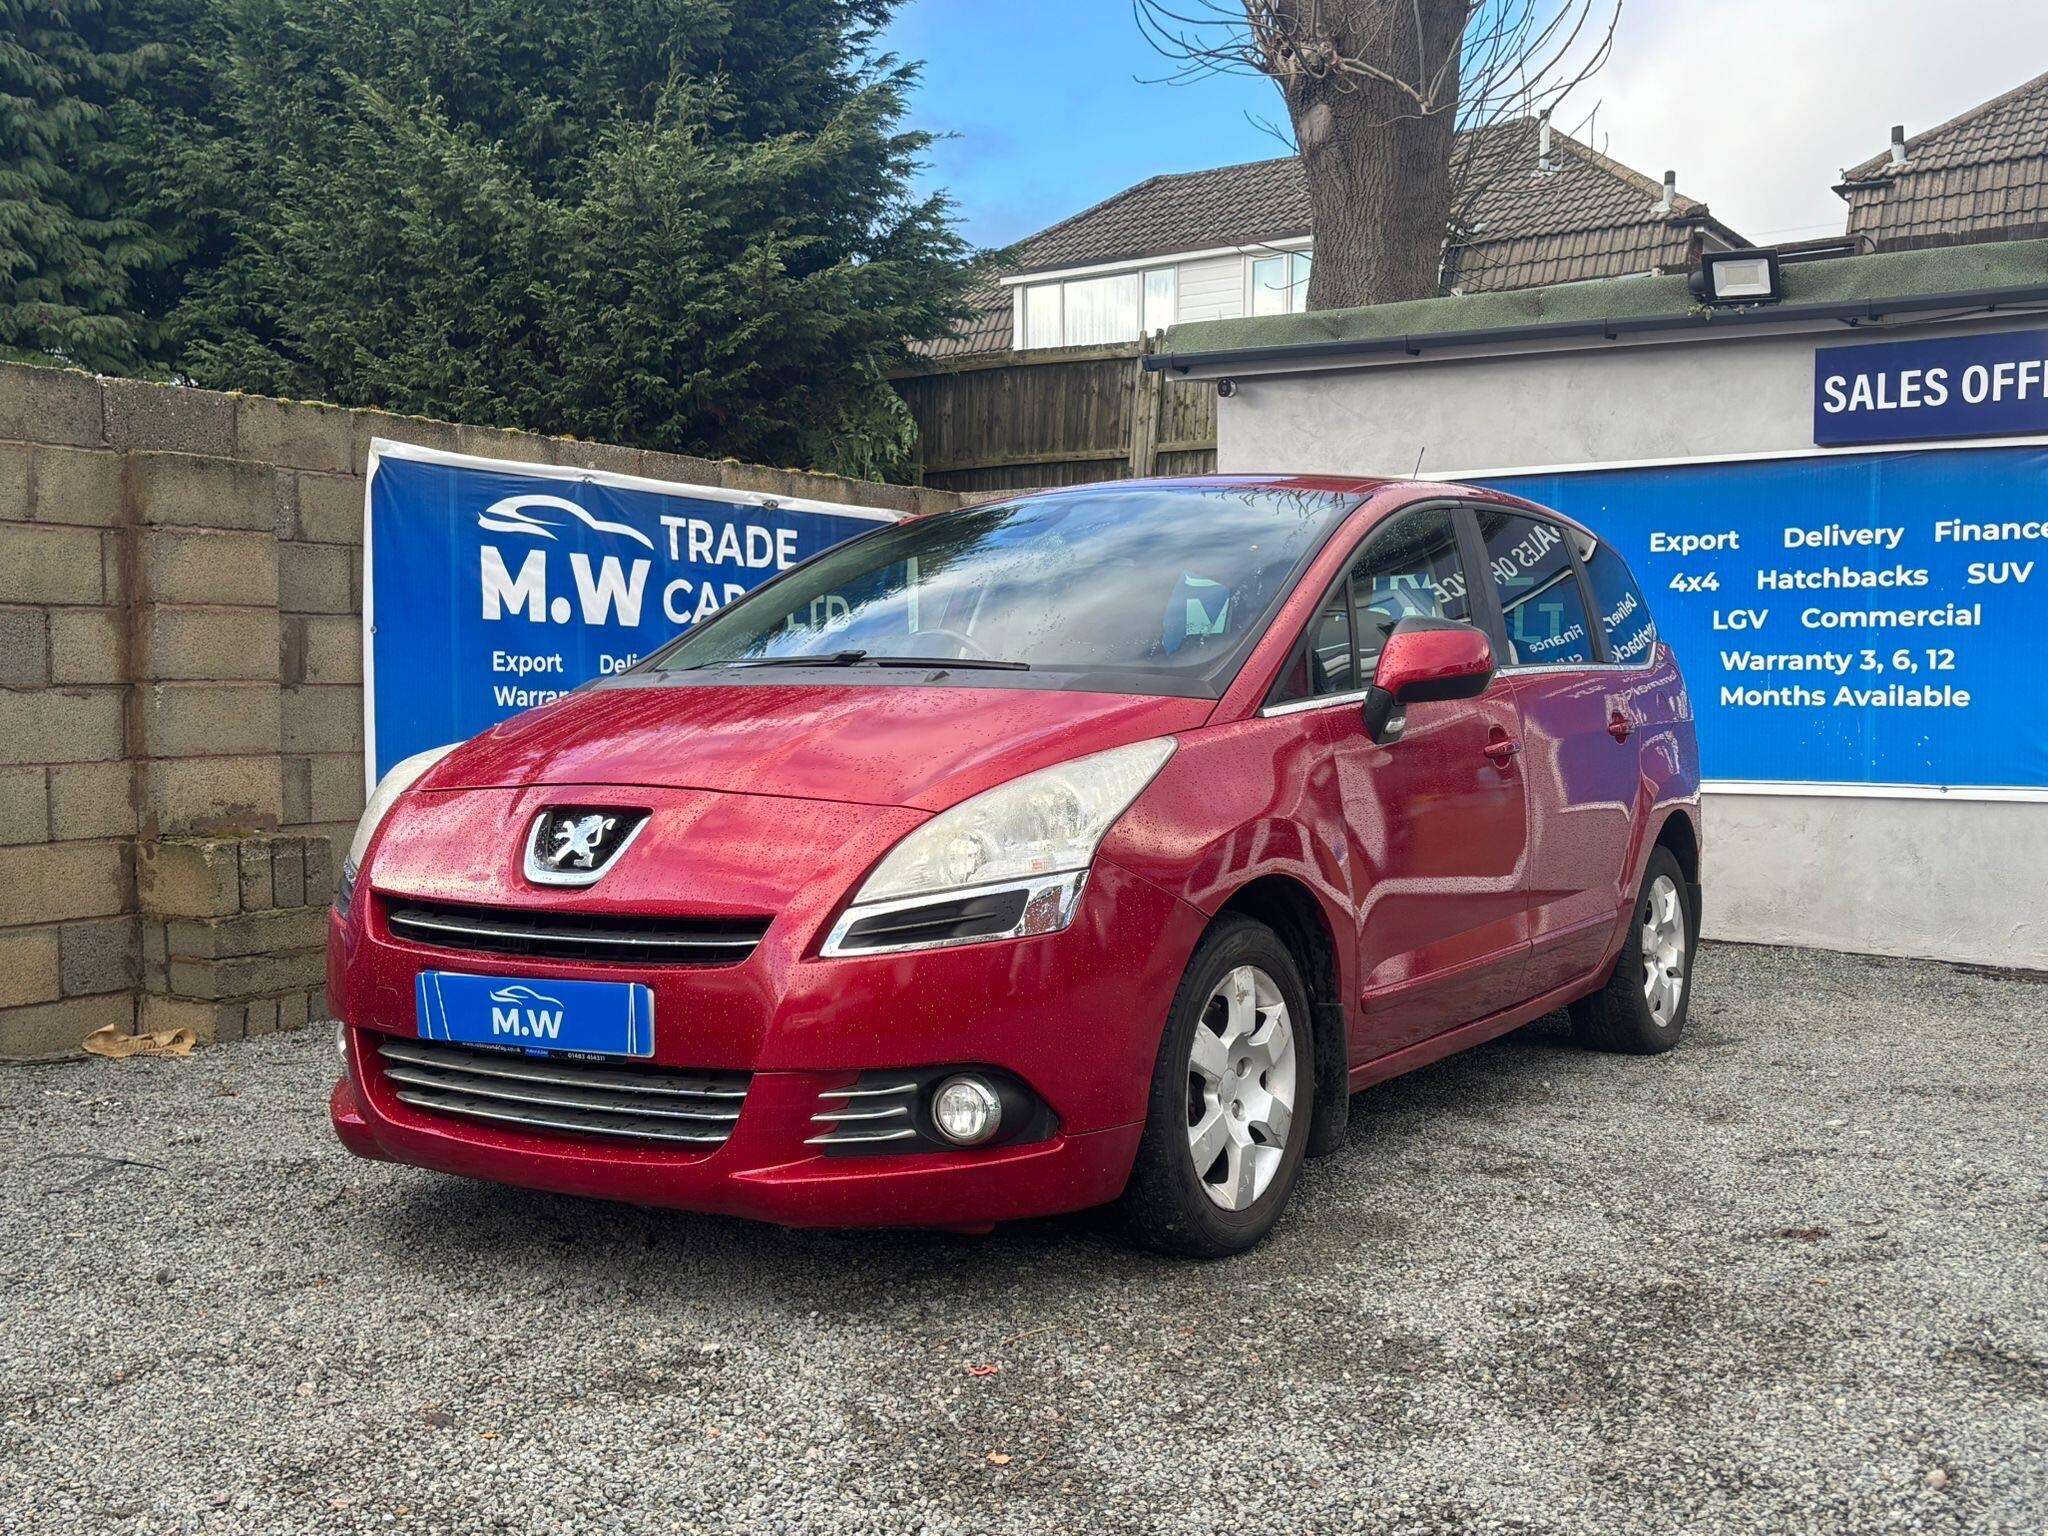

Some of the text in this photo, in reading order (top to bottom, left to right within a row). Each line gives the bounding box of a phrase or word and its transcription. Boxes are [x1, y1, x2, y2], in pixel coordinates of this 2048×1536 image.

[1823, 367, 1949, 413] SALES
[660, 514, 798, 571] TRADE
[1650, 530, 1740, 556] Export
[1784, 523, 1905, 550] Delivery
[480, 545, 652, 627] M.W
[1669, 561, 2035, 592] 4x4 Hatchbacks SUV
[1713, 602, 1981, 630] LGV Commercial
[492, 650, 564, 677] Export
[1720, 648, 1955, 676] Warranty 3, 6, 12
[1720, 683, 1971, 707] Months Available
[491, 1006, 564, 1039] M.W
